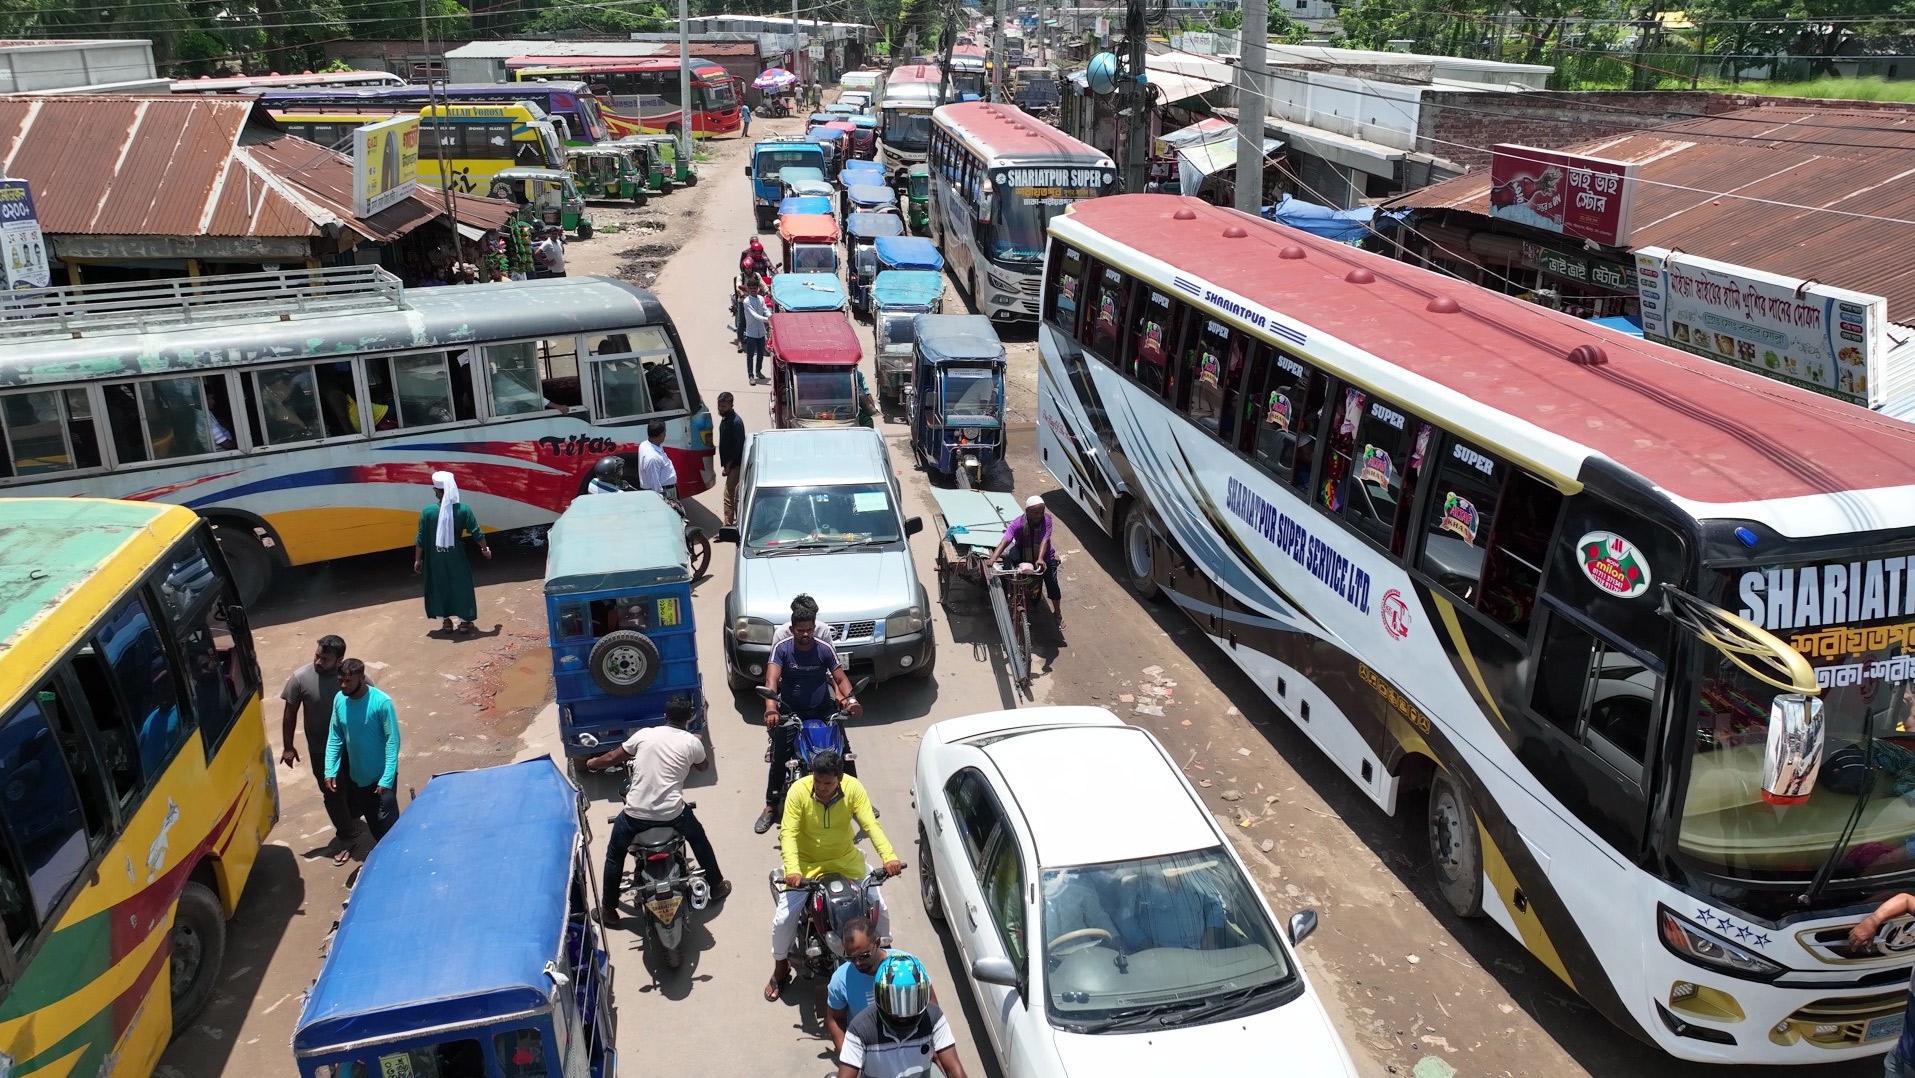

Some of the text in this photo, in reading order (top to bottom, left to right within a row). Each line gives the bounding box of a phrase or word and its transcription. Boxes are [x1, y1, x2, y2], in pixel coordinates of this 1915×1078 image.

[1007, 169, 1101, 187] SHARIATPUR SUPER
[1569, 165, 1620, 195] ভাই ভাই
[1576, 190, 1608, 213] স্টোর
[1549, 257, 1567, 275] ভাই
[1567, 261, 1586, 280] ভাই
[1204, 291, 1266, 328] SHARIATPUR
[1207, 321, 1229, 339] SUPER
[1277, 355, 1304, 377] SUPER
[1371, 403, 1406, 430] SUPER
[539, 433, 617, 457] Titas
[1453, 443, 1494, 476] SUPER
[1226, 476, 1278, 544] SHARIATPUR
[1277, 513, 1307, 566] SUPER
[1306, 534, 1348, 598] SERVICE
[1347, 563, 1371, 616] LTD.
[1596, 561, 1625, 581] milon
